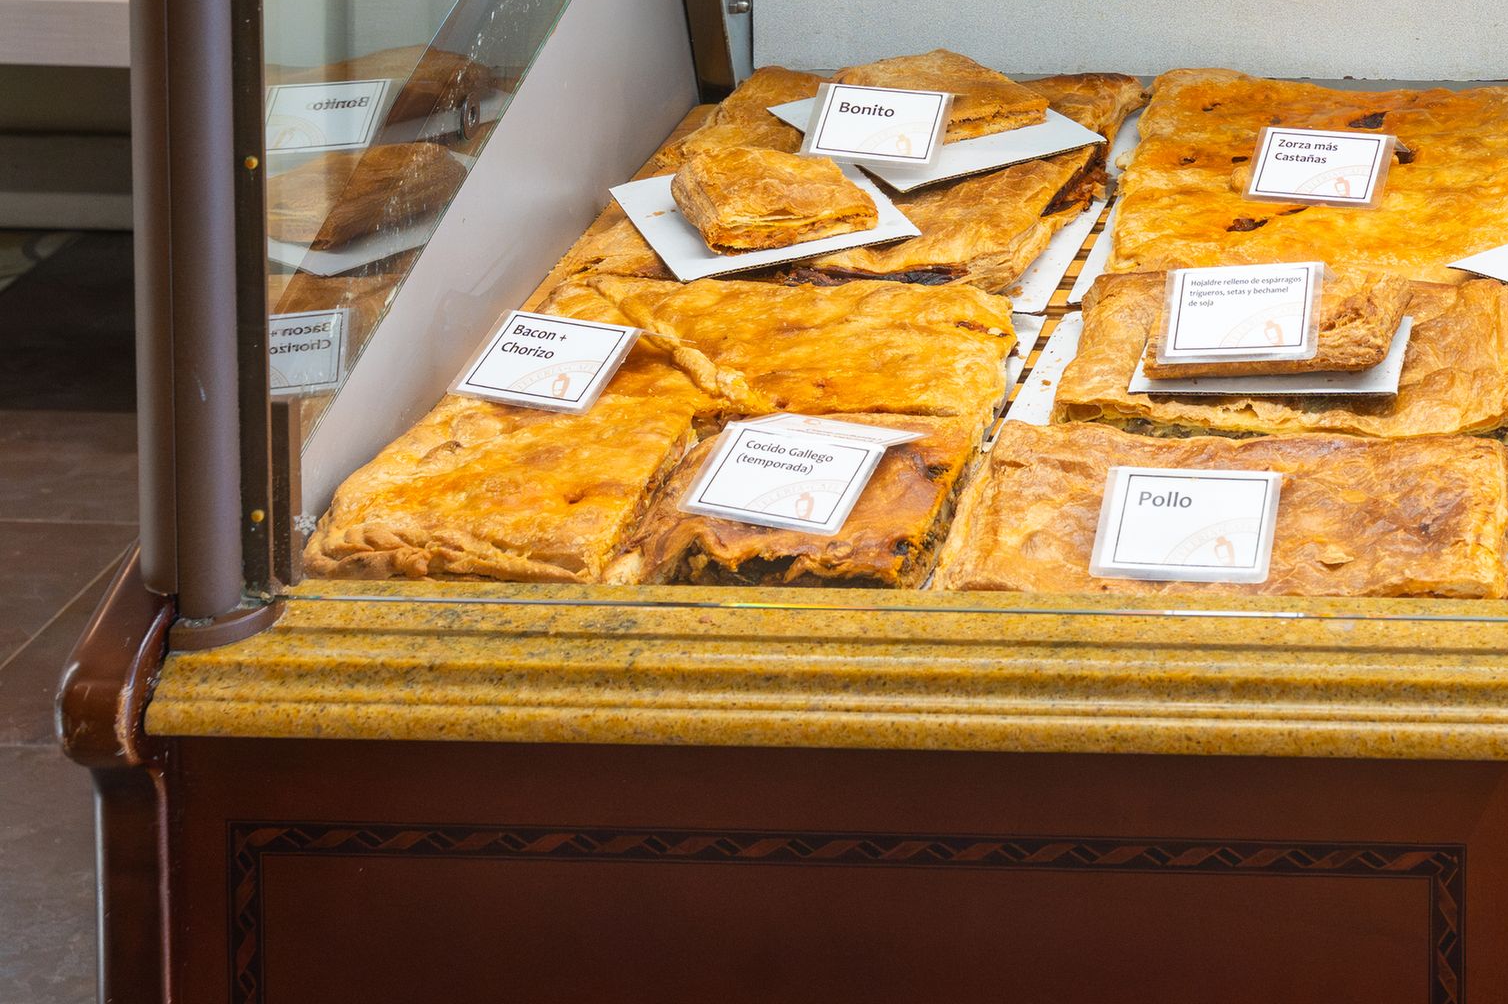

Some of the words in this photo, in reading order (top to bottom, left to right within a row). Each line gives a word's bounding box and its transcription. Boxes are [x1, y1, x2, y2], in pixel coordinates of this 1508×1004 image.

[839, 101, 895, 117] Bonito
[1278, 139, 1311, 150] Zorza
[1314, 142, 1338, 151] más
[1275, 152, 1327, 164] Castañas
[1191, 279, 1222, 288] Hojaldre
[1223, 278, 1249, 286] relleno
[1261, 276, 1301, 285] espárragos
[1190, 289, 1225, 298] trigueros,
[1253, 286, 1289, 294] bechamel
[1199, 300, 1214, 308] soja
[513, 324, 556, 341] Bacon
[501, 342, 554, 359] Chorizo
[746, 440, 786, 455] Cocido
[788, 447, 834, 463] Gallego
[736, 452, 814, 475] (temporada)
[1138, 491, 1192, 508] Pollo
